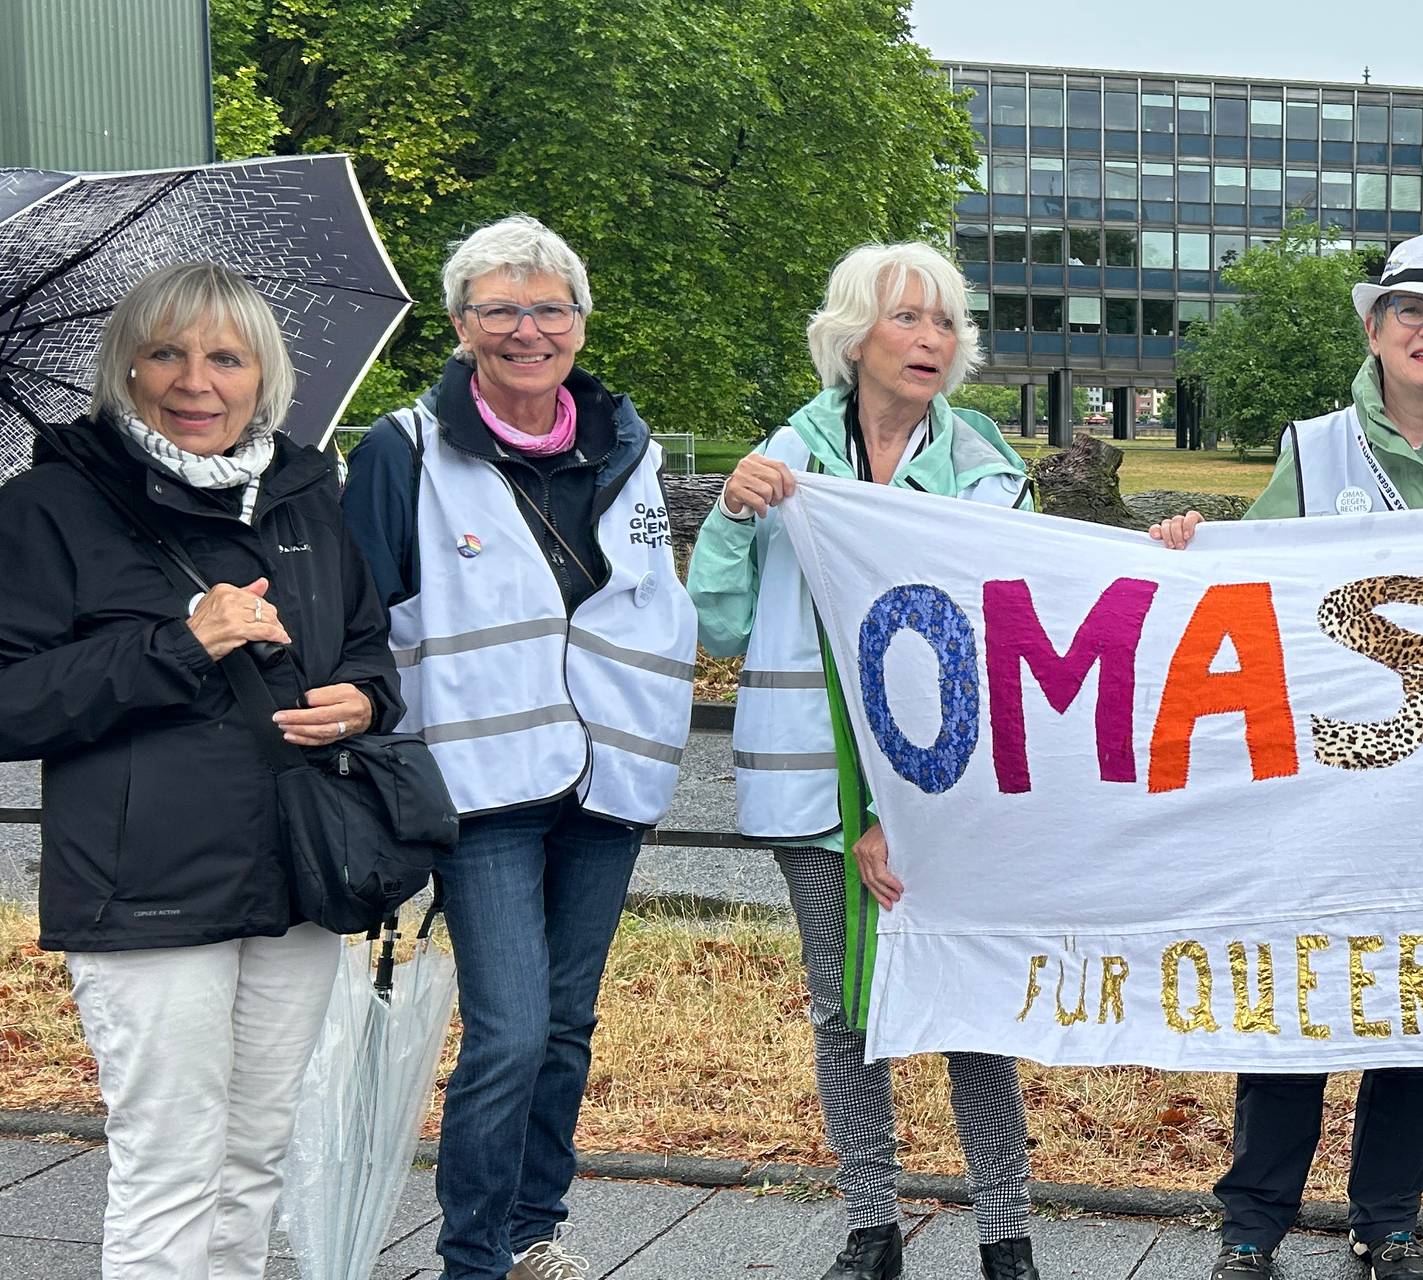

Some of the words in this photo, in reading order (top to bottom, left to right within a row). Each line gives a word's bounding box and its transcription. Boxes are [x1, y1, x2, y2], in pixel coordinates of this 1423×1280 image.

[1362, 445, 1379, 473] RECHTS
[1342, 491, 1364, 499] OMAS
[1376, 473, 1396, 499] GEGEN
[1340, 498, 1366, 506] GEGEN
[1340, 504, 1368, 513] RECHTS
[634, 503, 667, 520] OAS
[629, 517, 668, 535] GEN
[629, 531, 673, 549] REHTS
[1015, 935, 1130, 1027] FÜR
